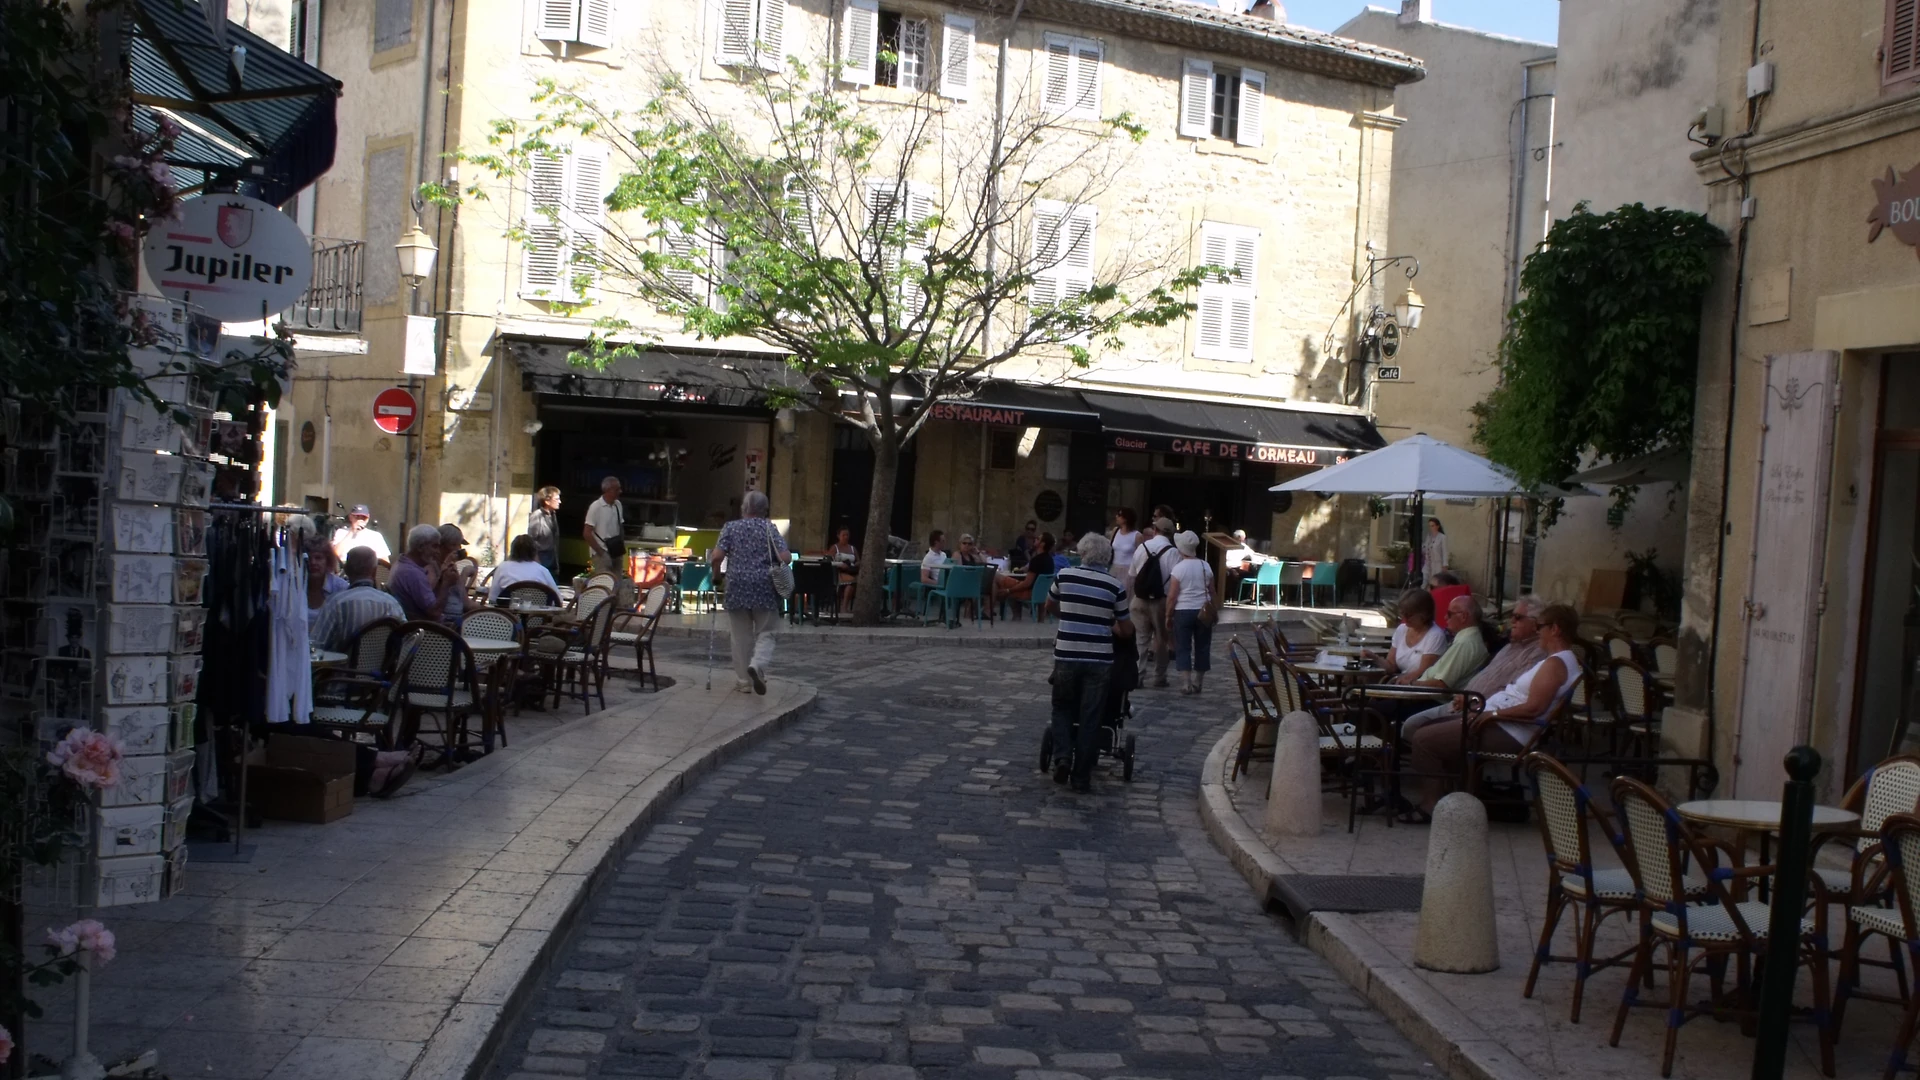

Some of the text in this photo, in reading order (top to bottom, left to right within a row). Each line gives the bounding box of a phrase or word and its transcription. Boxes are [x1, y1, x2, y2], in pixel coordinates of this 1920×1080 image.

[164, 245, 293, 284] Jupiler
[1379, 369, 1398, 378] Café
[1115, 436, 1148, 449] Glacier
[1172, 439, 1316, 464] CAFE DE L'ORMEAU
